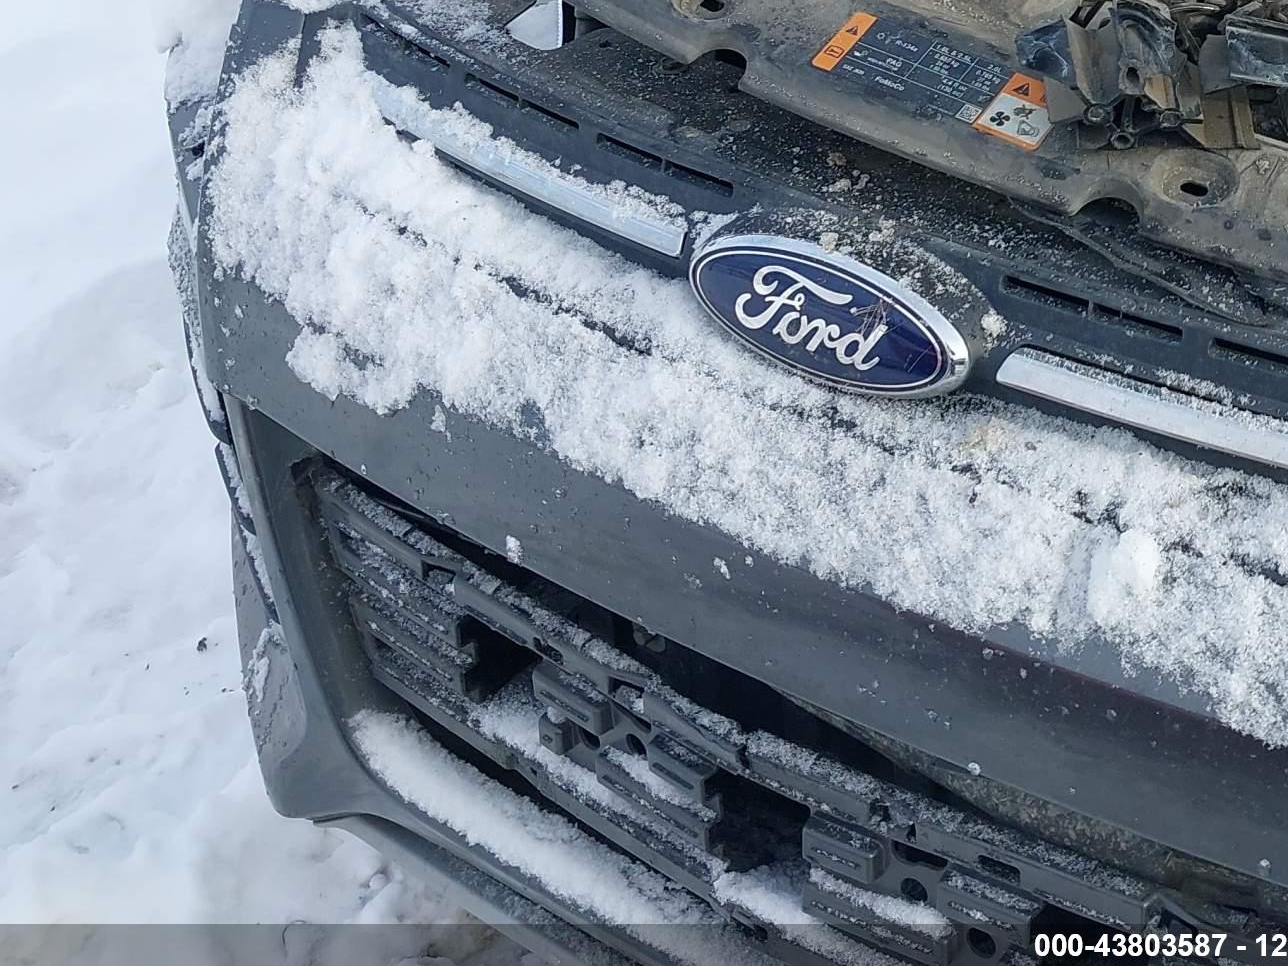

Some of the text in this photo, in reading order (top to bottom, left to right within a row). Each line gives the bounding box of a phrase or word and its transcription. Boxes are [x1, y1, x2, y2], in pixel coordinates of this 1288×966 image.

[987, 64, 1002, 74] 2.0L
[874, 75, 905, 92] FoMoCo
[735, 265, 888, 371] Ford
